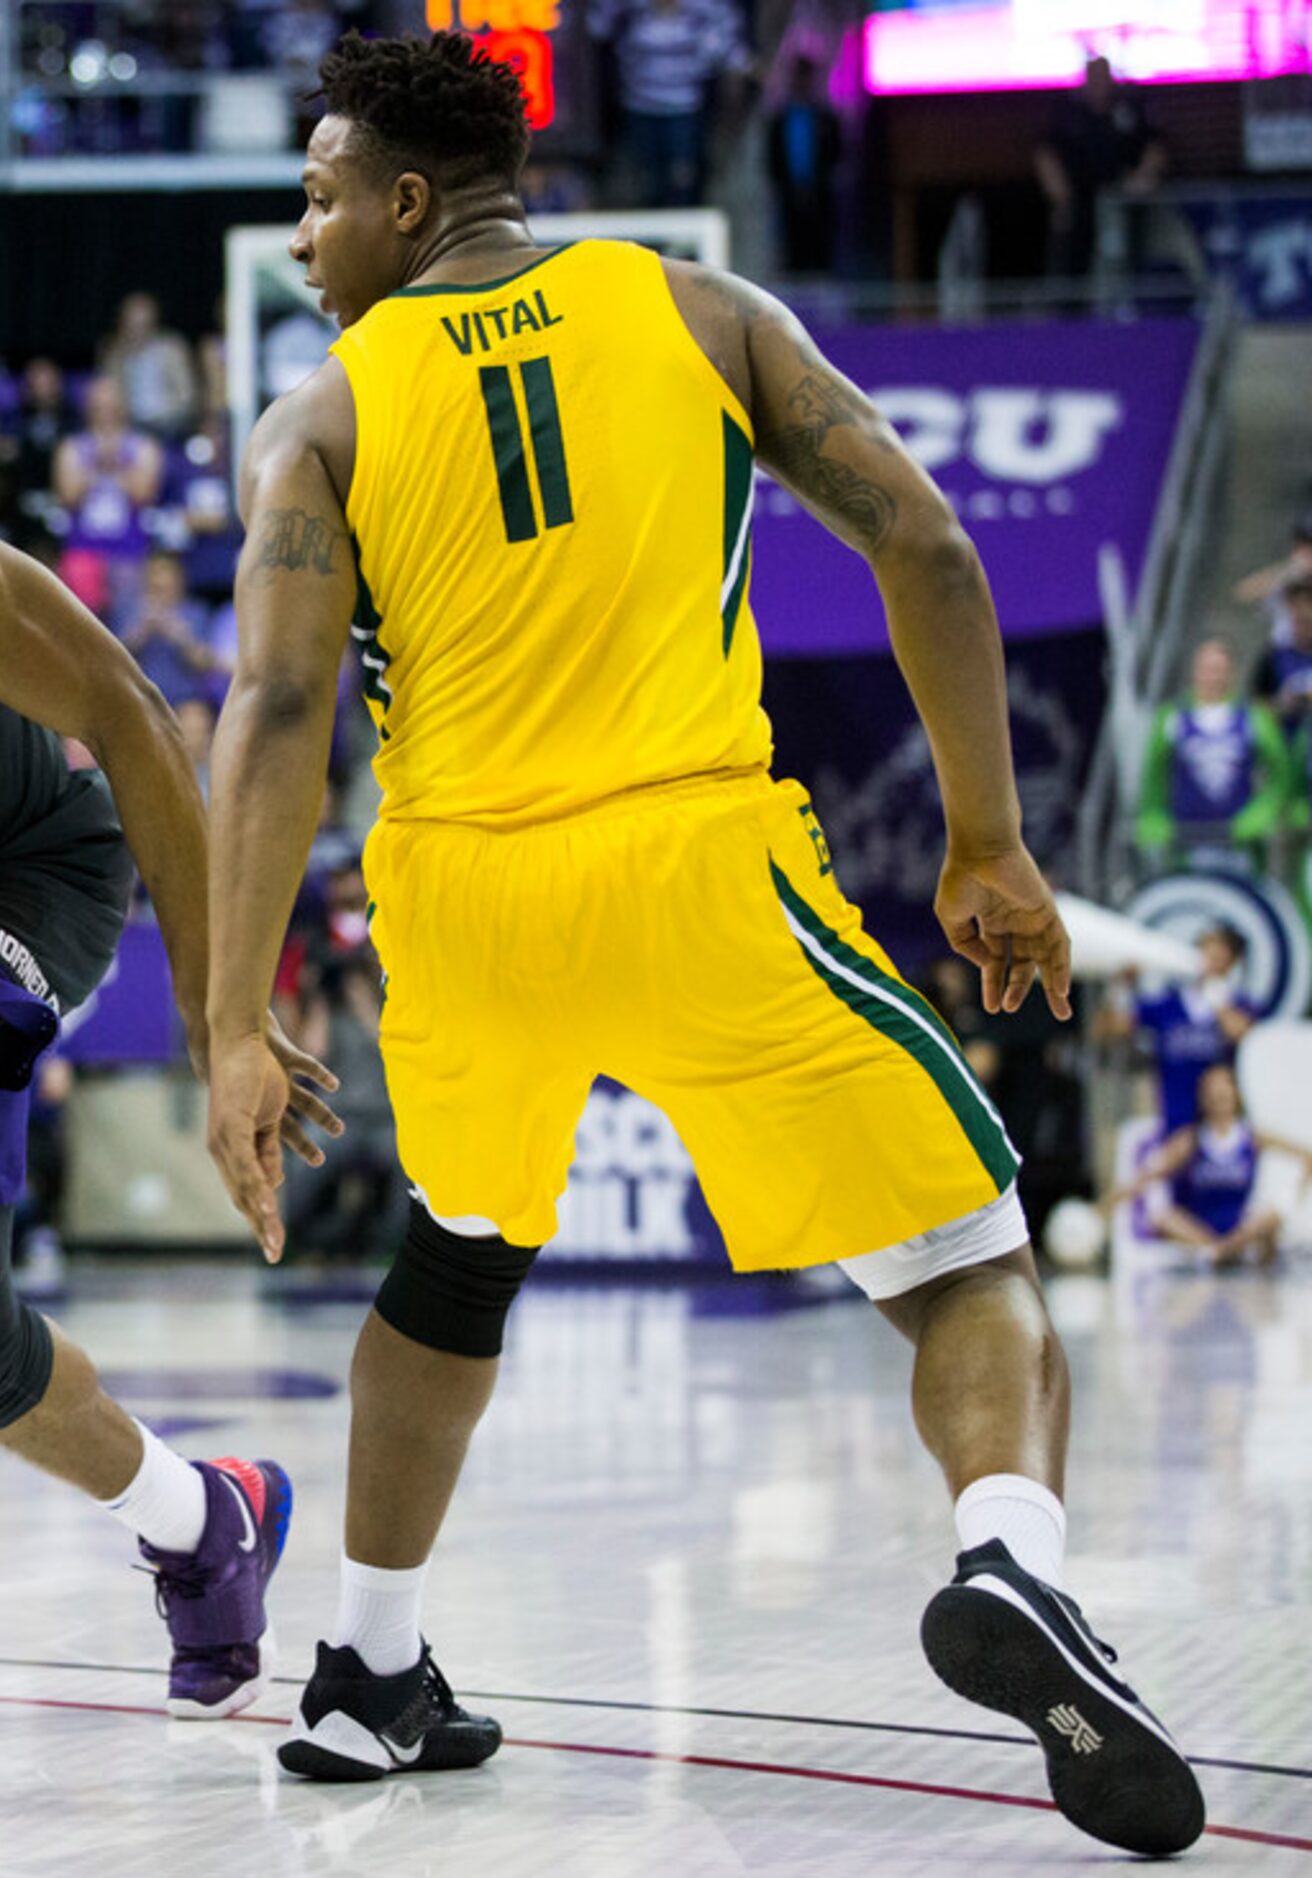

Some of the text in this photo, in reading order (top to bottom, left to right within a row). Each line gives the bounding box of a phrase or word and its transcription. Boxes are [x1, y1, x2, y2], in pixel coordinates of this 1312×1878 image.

[440, 289, 564, 356] VITAL
[478, 355, 574, 544] 11
[866, 384, 1122, 486] CU
